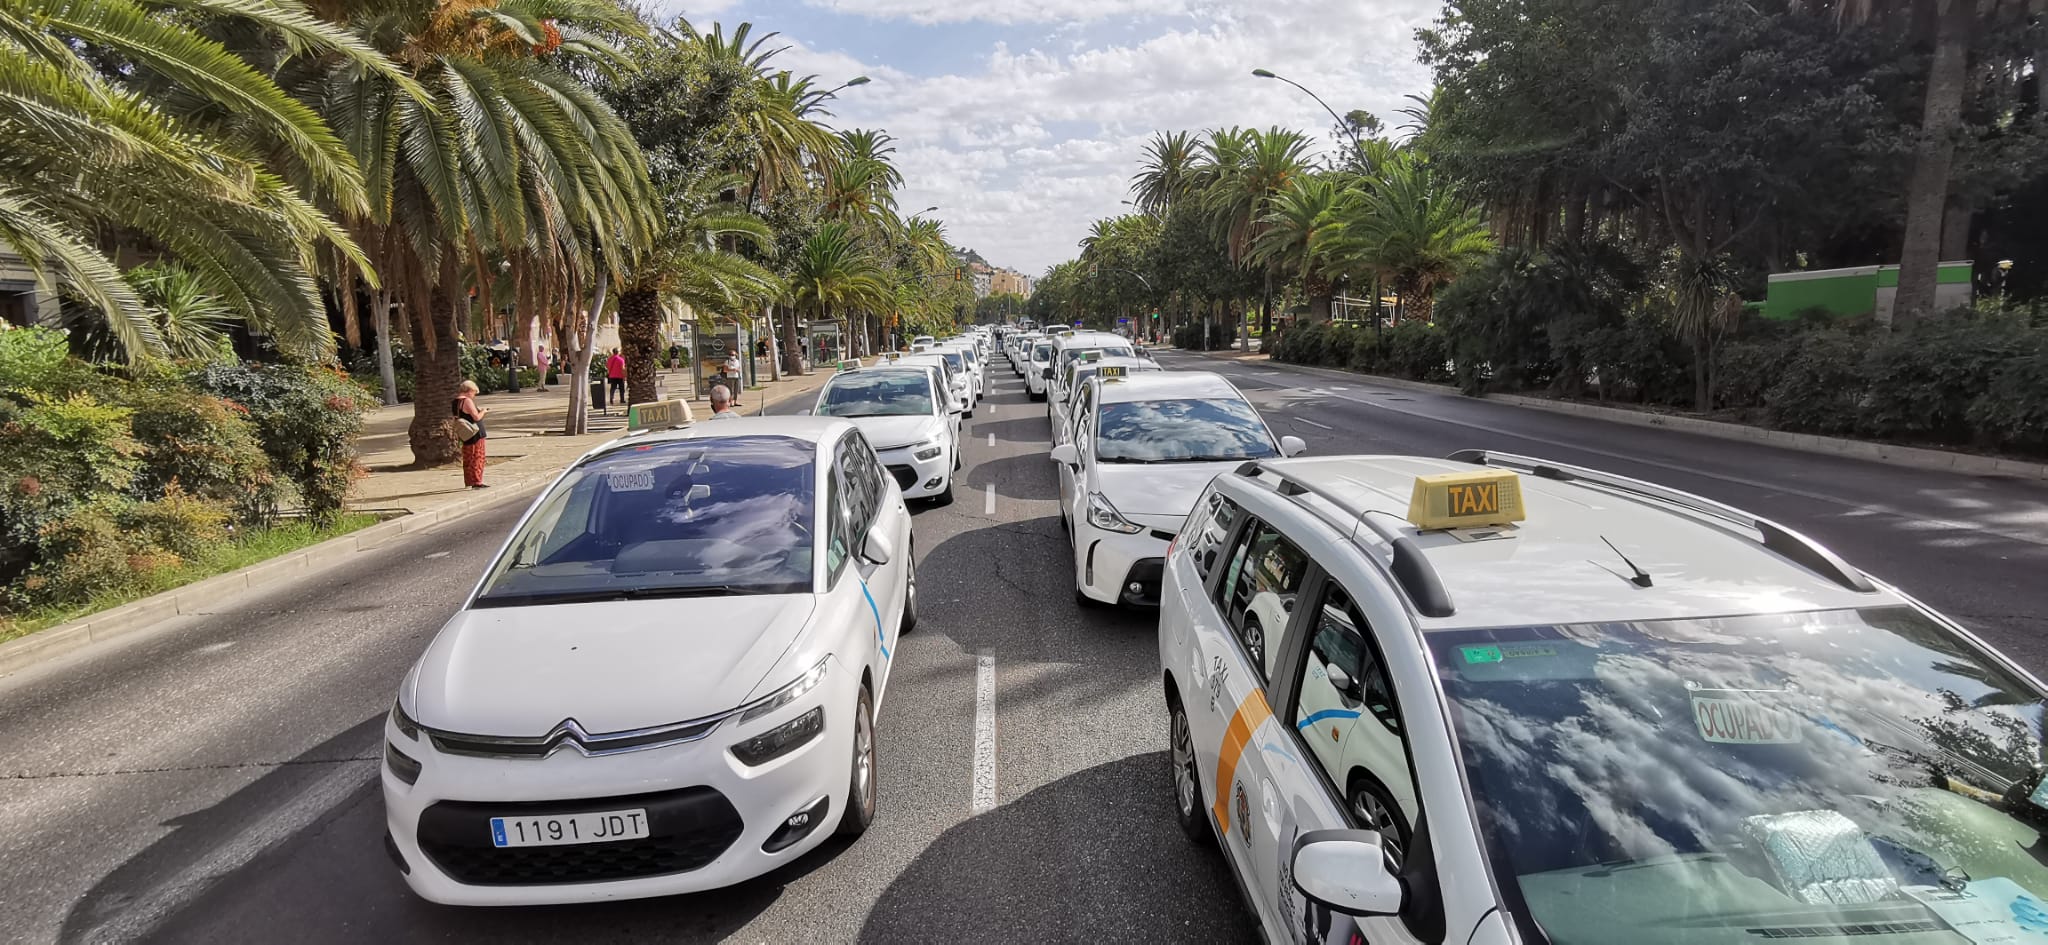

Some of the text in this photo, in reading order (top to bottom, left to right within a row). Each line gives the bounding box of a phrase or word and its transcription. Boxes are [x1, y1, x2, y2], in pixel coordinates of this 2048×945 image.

[1103, 368, 1120, 377] TAXI
[641, 405, 668, 424] TAXI
[612, 473, 649, 490] OCUPADO
[1449, 483, 1498, 514] TAXI
[1213, 655, 1229, 684] TAXI
[1698, 701, 1793, 740] OCUPADO
[515, 813, 641, 843] 1191 JDT
